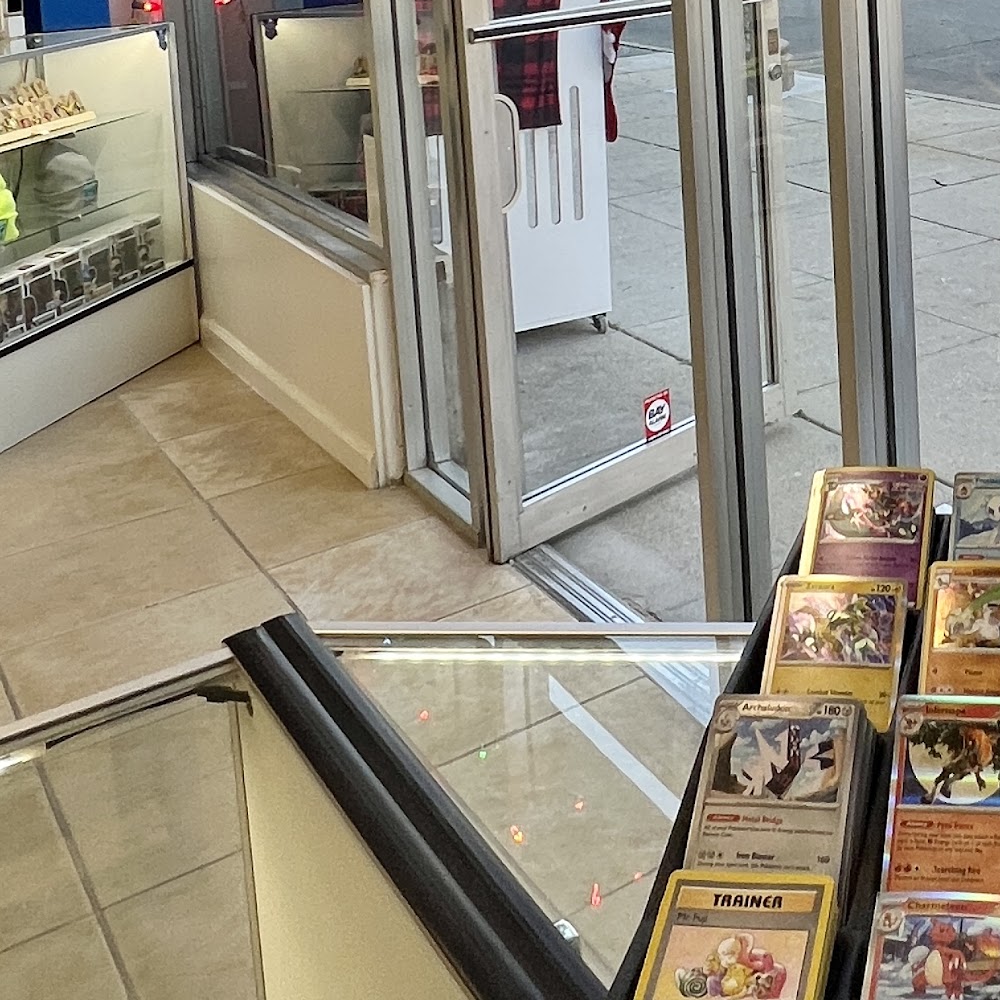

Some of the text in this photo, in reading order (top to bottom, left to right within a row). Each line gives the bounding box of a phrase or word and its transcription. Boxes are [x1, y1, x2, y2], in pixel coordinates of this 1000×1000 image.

[876, 584, 891, 592] 120
[823, 705, 841, 716] 180
[713, 893, 783, 909] TRAINER
